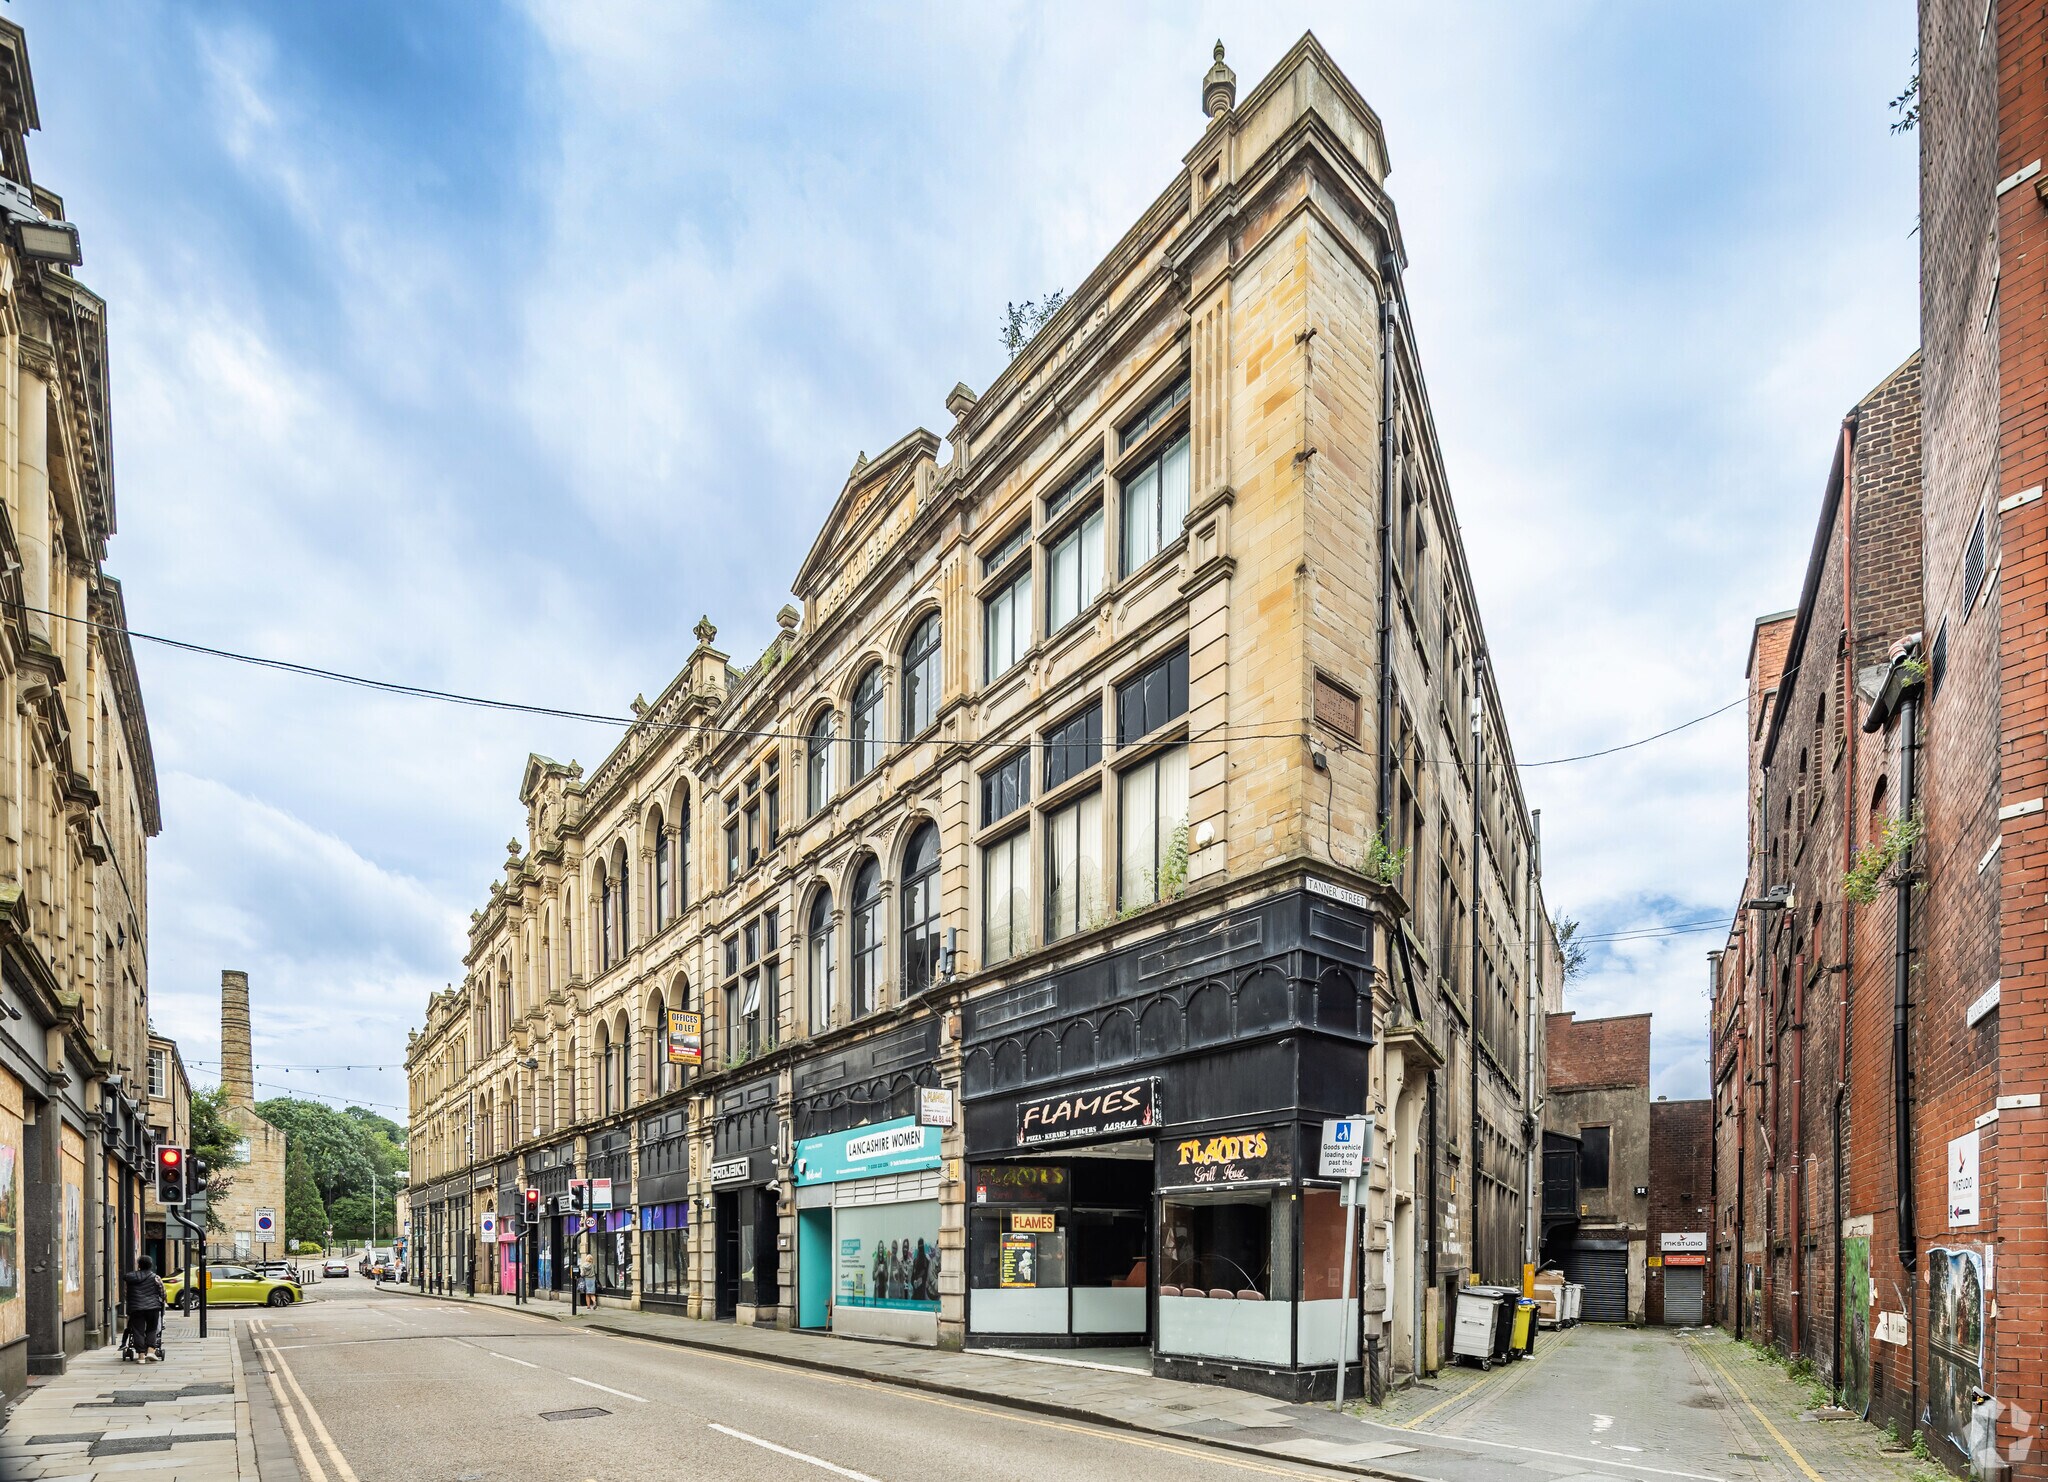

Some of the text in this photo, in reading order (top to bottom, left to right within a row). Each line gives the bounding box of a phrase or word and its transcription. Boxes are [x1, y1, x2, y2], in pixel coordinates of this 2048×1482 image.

[1308, 879, 1365, 907] TANNER STREET
[671, 1012, 698, 1024] OFFICES
[675, 1022, 695, 1033] TO LET
[1023, 1086, 1141, 1129] FLAMES
[1026, 1119, 1138, 1143] PIZZA KEBABS BURGERS 448844
[848, 1130, 921, 1157] LANCASHIRE WOMEN
[1177, 1131, 1268, 1166] FLAMES
[1194, 1164, 1249, 1183] Grill House
[1013, 1216, 1053, 1229] FLAMES
